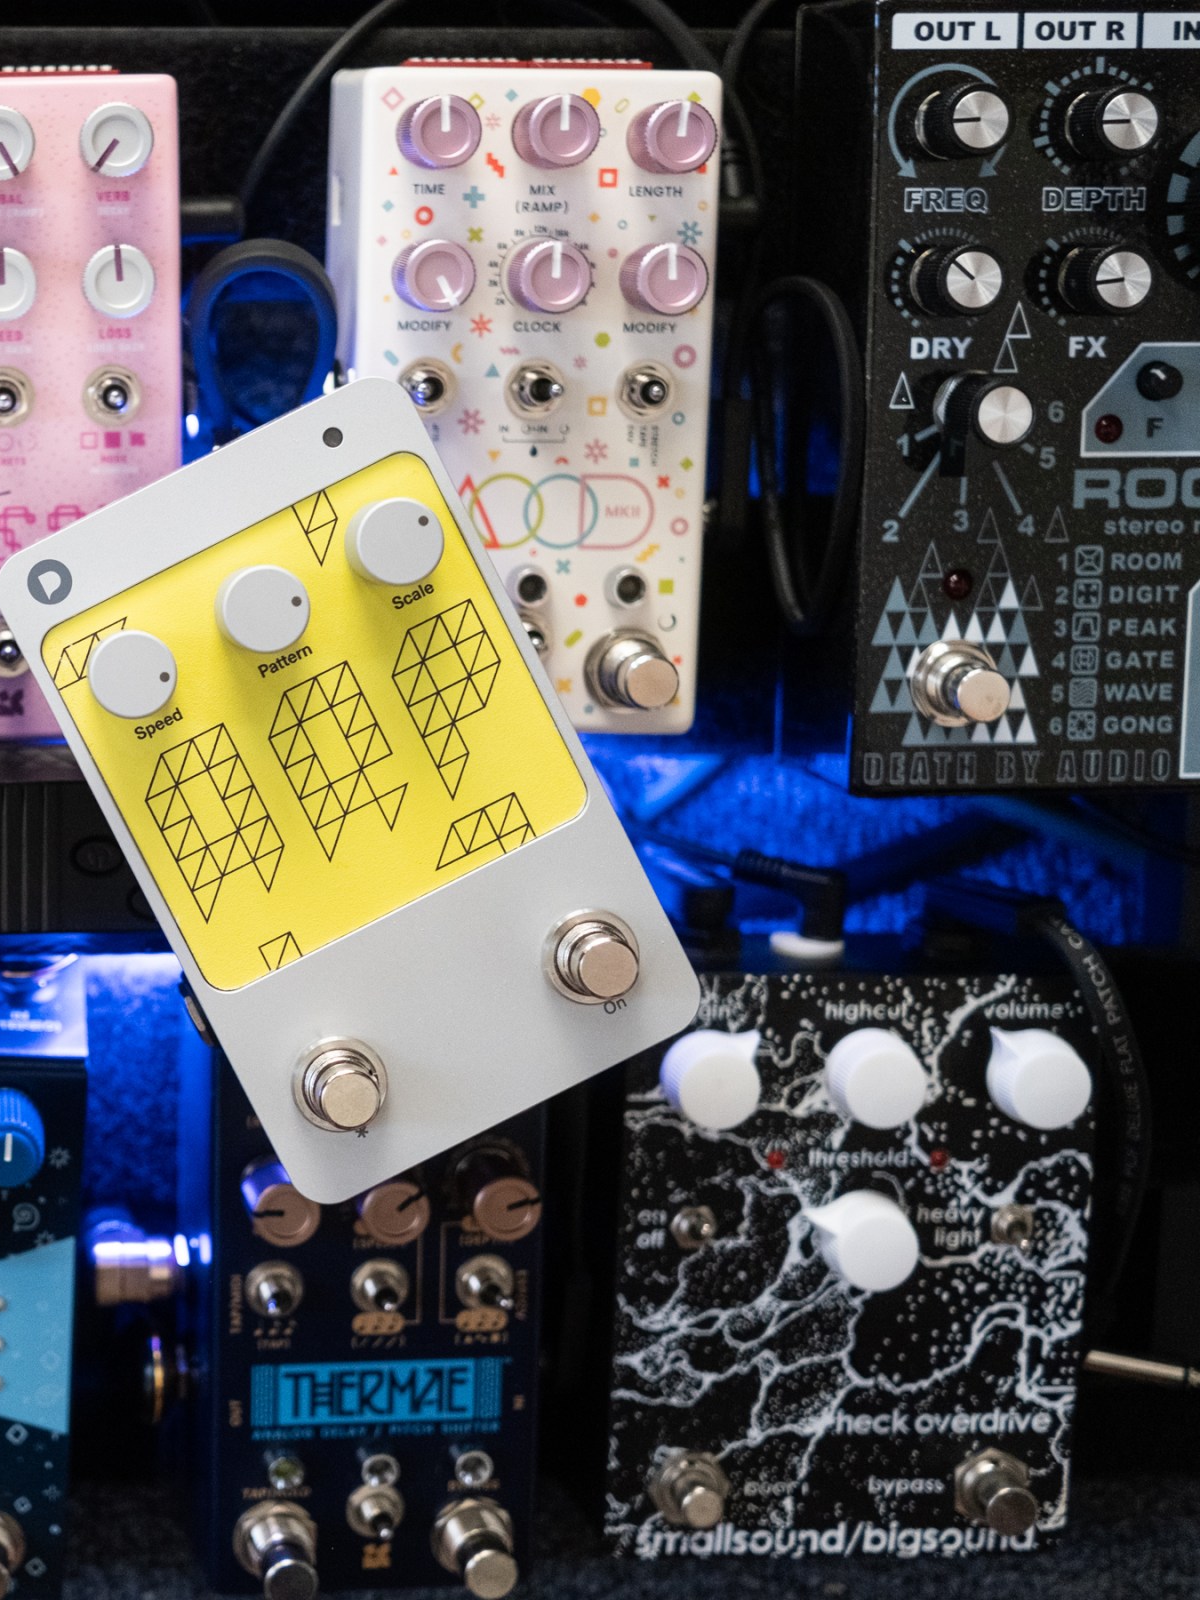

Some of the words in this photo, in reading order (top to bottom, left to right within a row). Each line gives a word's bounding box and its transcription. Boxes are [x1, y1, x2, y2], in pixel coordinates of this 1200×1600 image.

[913, 21, 974, 42] OUT
[985, 22, 1002, 41] L
[1034, 21, 1097, 41] OUT
[1105, 21, 1125, 41] R
[96, 189, 131, 204] VERB
[412, 183, 446, 196] TIME
[529, 185, 555, 196] MIX
[629, 185, 683, 198] LENGTH
[1041, 187, 1147, 212] DEPTH
[515, 201, 569, 215] (RAMP)
[904, 187, 989, 214] FREQ
[99, 327, 133, 341] LOSS
[397, 321, 451, 333] MODIFY
[513, 321, 561, 333] CLOCK
[623, 323, 677, 335] MODIFY
[909, 337, 973, 359] DRY
[1068, 337, 1107, 358] FX
[1048, 402, 1064, 423] 6
[897, 435, 910, 456] 1
[1039, 447, 1056, 469] 5
[605, 507, 640, 519] MKII
[953, 510, 969, 532] 3
[883, 520, 899, 542] 2
[1017, 514, 1035, 536] 4
[1103, 516, 1184, 536] stereo
[1058, 554, 1068, 571] 1
[1110, 552, 1183, 571] ROOM
[391, 580, 436, 612] Scale
[1056, 587, 1069, 605] 2
[1109, 585, 1179, 604] DIGIT
[1054, 619, 1067, 637] 3
[1107, 618, 1177, 637] PEAK
[256, 644, 314, 680] Pattern
[1051, 652, 1066, 670] 4
[1105, 651, 1175, 670] GATE
[1051, 685, 1064, 702] 5
[1103, 683, 1174, 702] WAVE
[133, 708, 184, 742] Speed
[1049, 717, 1063, 735] 6
[1102, 716, 1174, 735] GONG
[863, 752, 978, 785] DEATH
[997, 750, 1042, 783] BY
[1056, 748, 1171, 783] AUDIO
[603, 997, 628, 1015] On
[825, 1000, 907, 1021] highcut
[984, 1000, 1064, 1019] volume
[808, 1149, 908, 1167] threshold
[917, 1206, 984, 1227] heavy
[636, 1230, 666, 1250] off
[934, 1228, 983, 1248] light
[283, 1367, 472, 1418] THERMAE
[914, 1409, 1052, 1435] overdrive
[868, 1476, 945, 1495] bypass
